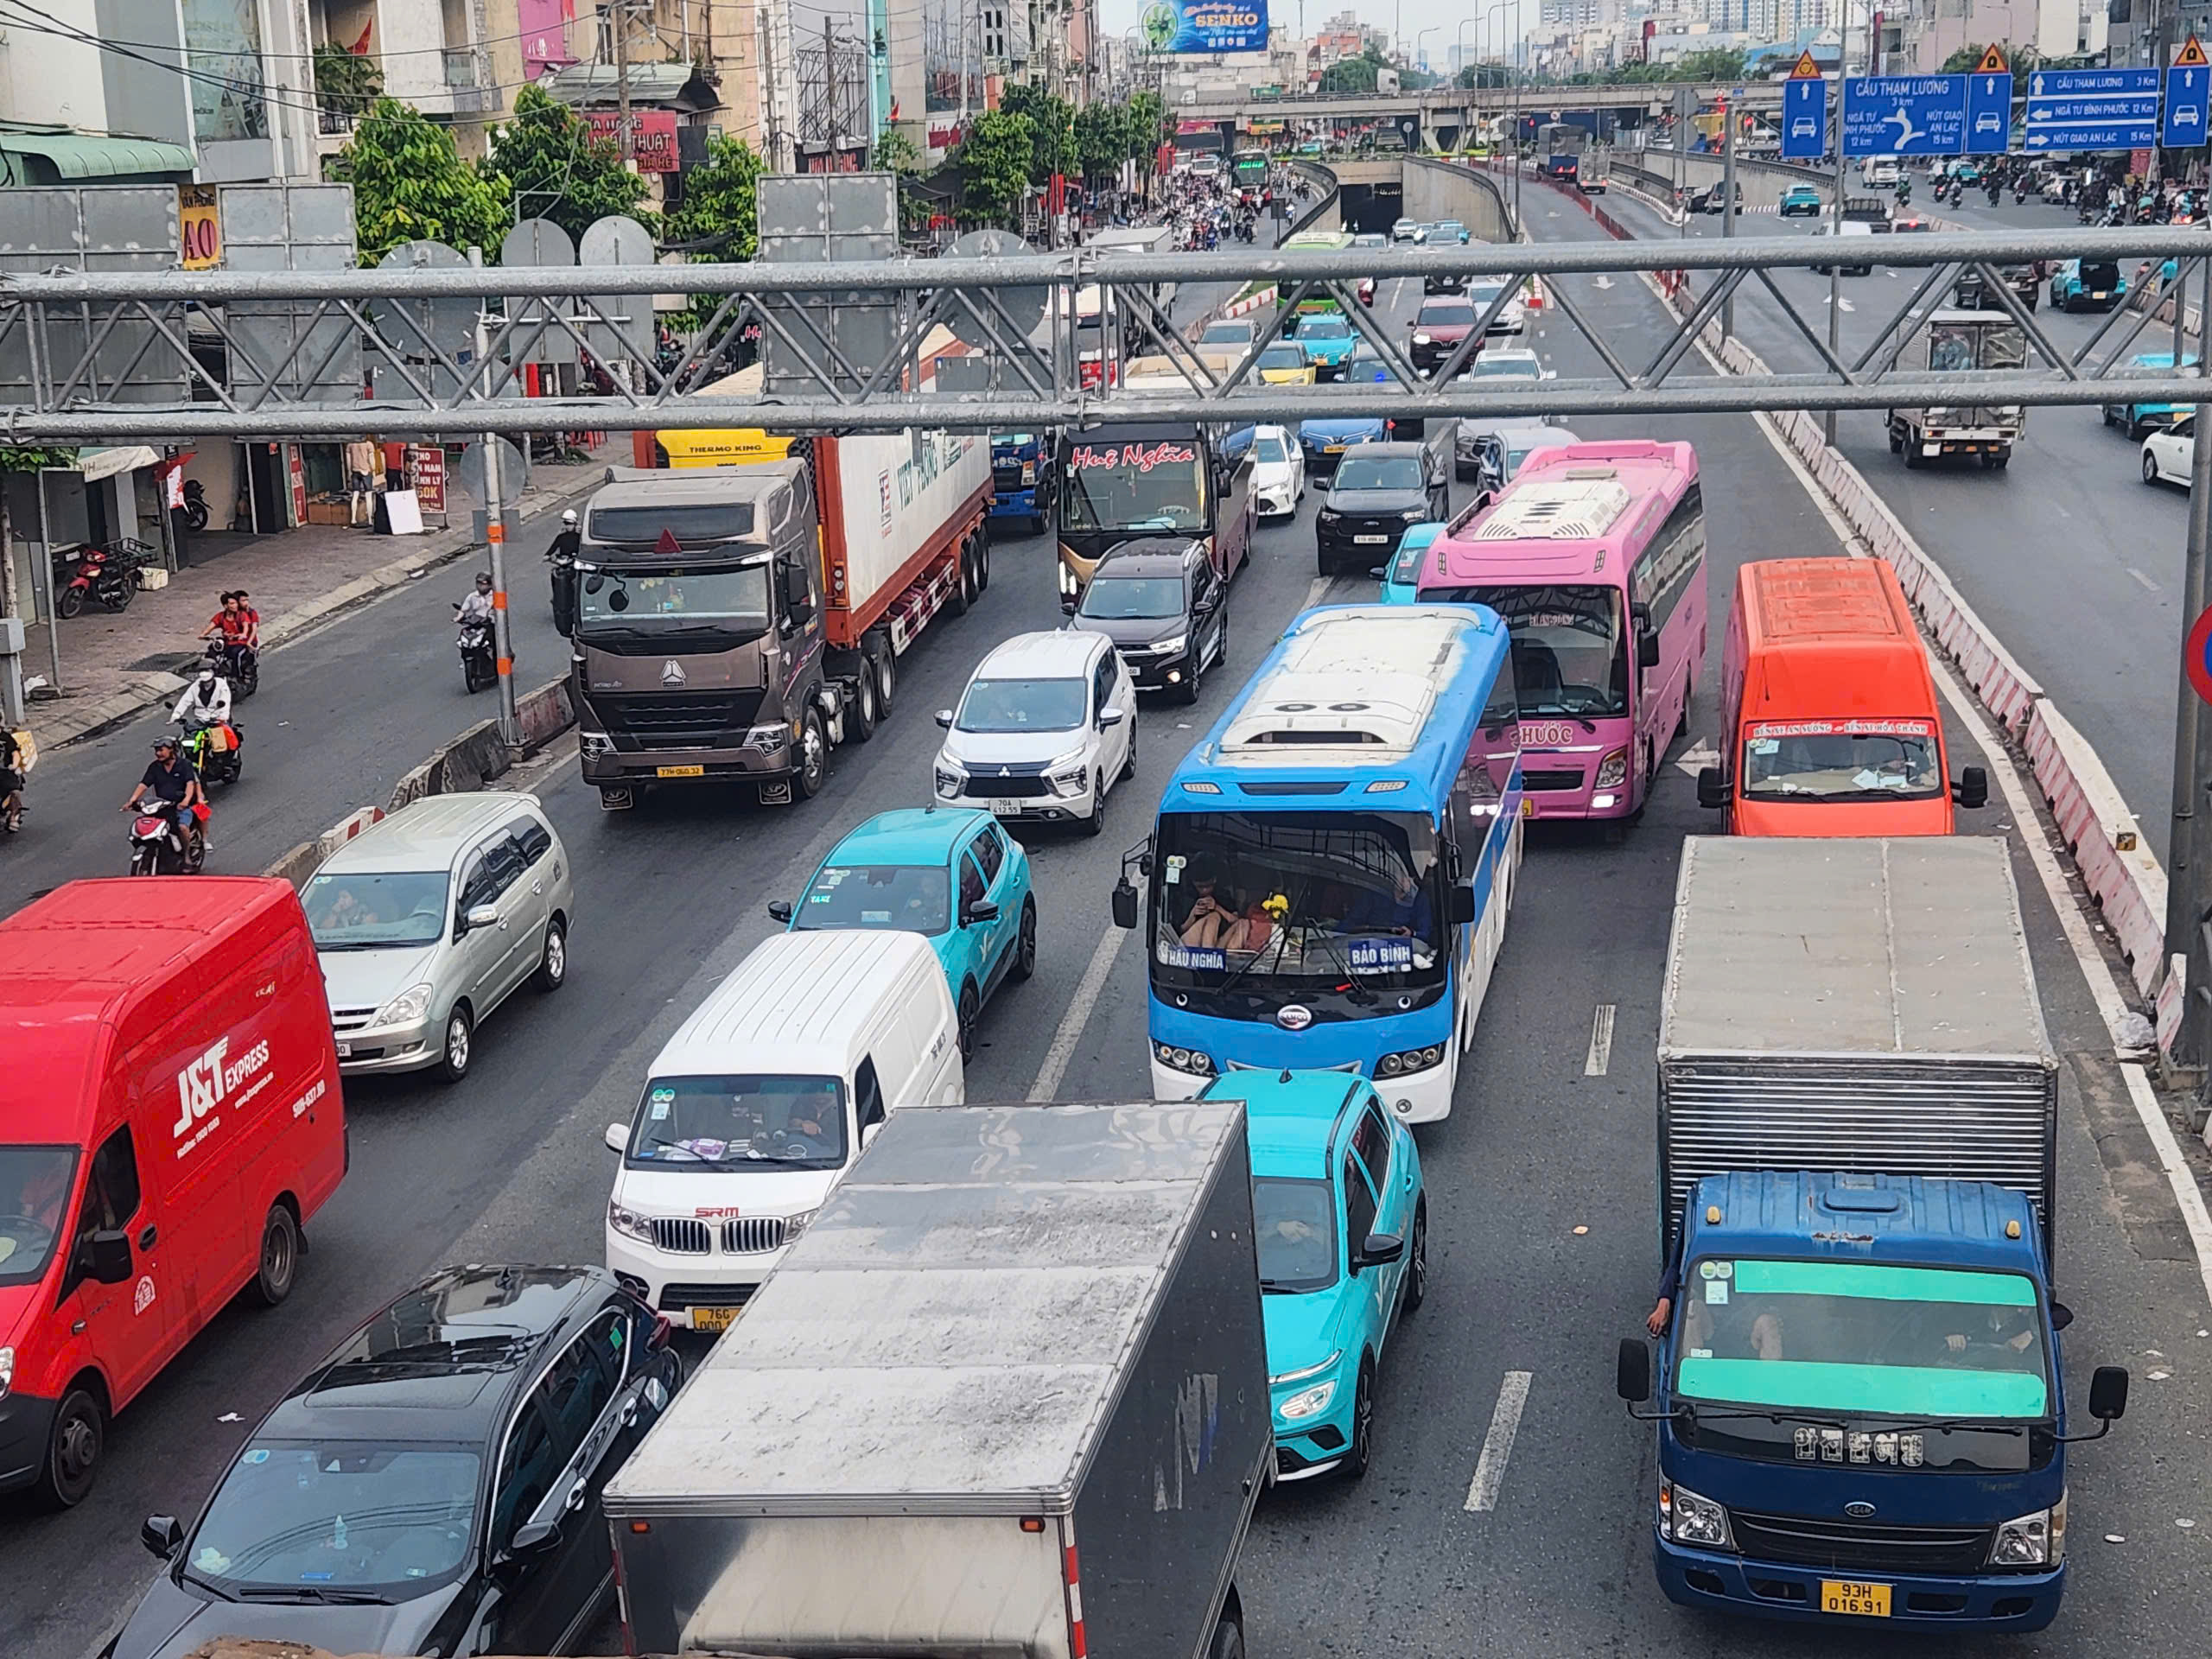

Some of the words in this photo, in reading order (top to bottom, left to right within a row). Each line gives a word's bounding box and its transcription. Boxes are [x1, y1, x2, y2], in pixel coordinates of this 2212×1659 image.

[1196, 13, 1258, 27] SENKO
[1879, 81, 1910, 96] THAM
[2074, 78, 2095, 88] THAM
[1891, 98, 1898, 106] 3
[2133, 104, 2140, 113] 12
[1944, 110, 1963, 121] GIAO
[1850, 137, 1859, 147] 12
[2069, 133, 2088, 143] GIAO
[2088, 133, 2101, 143] AN
[2130, 131, 2139, 142] 15
[1072, 446, 1118, 470] Huệ
[1122, 442, 1194, 473] Nghĩa
[174, 1035, 229, 1139] J&T
[225, 1039, 270, 1094] EXPRESS
[695, 1207, 740, 1217] SRM
[1841, 1585, 1872, 1599] 93H
[1828, 1597, 1883, 1614] 016.91
